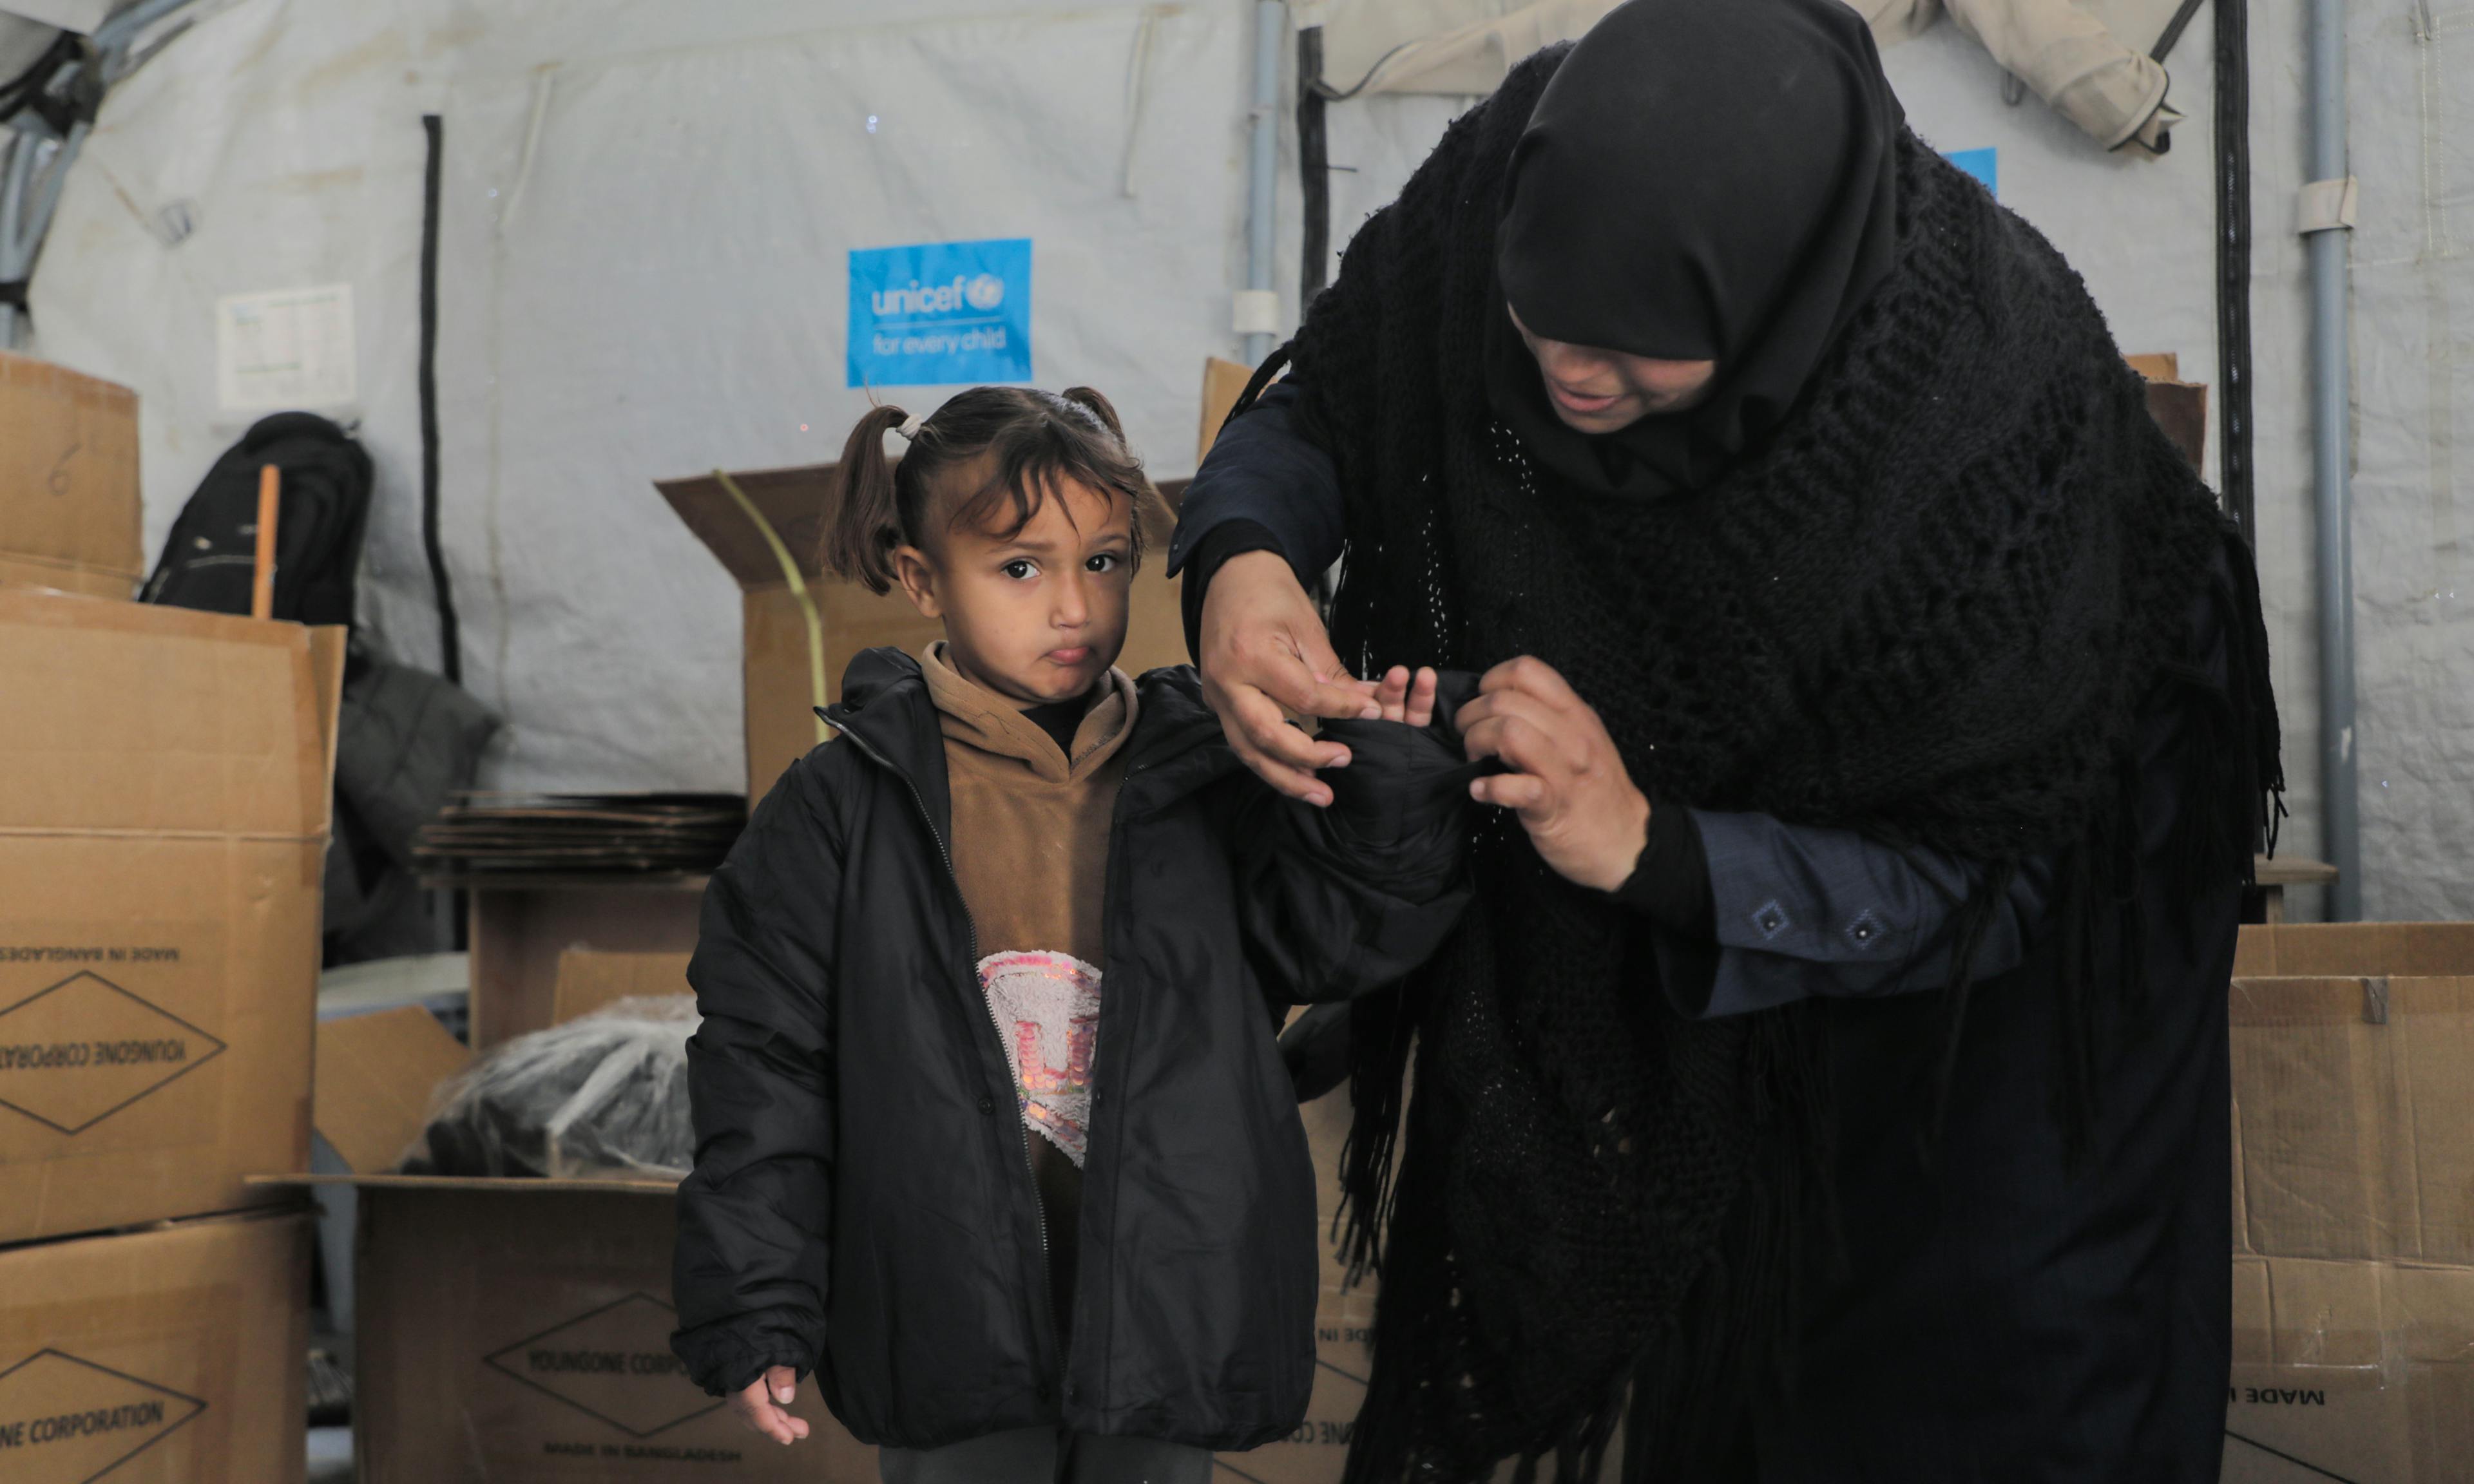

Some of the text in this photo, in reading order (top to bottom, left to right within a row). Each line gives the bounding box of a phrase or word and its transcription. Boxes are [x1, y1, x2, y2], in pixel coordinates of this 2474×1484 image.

[872, 275, 965, 316] unicef
[873, 326, 1006, 356] for every child
[109, 947, 126, 961] IN
[133, 947, 180, 961] MADE
[95, 1038, 186, 1065] YOUNGONE
[1318, 1327, 1339, 1342] IN
[528, 1351, 625, 1375] YOUNGONE
[2245, 1387, 2325, 1405] MADE
[30, 1400, 164, 1443] CORPORATION
[543, 1441, 742, 1462] MADE IN BANGLADESH
